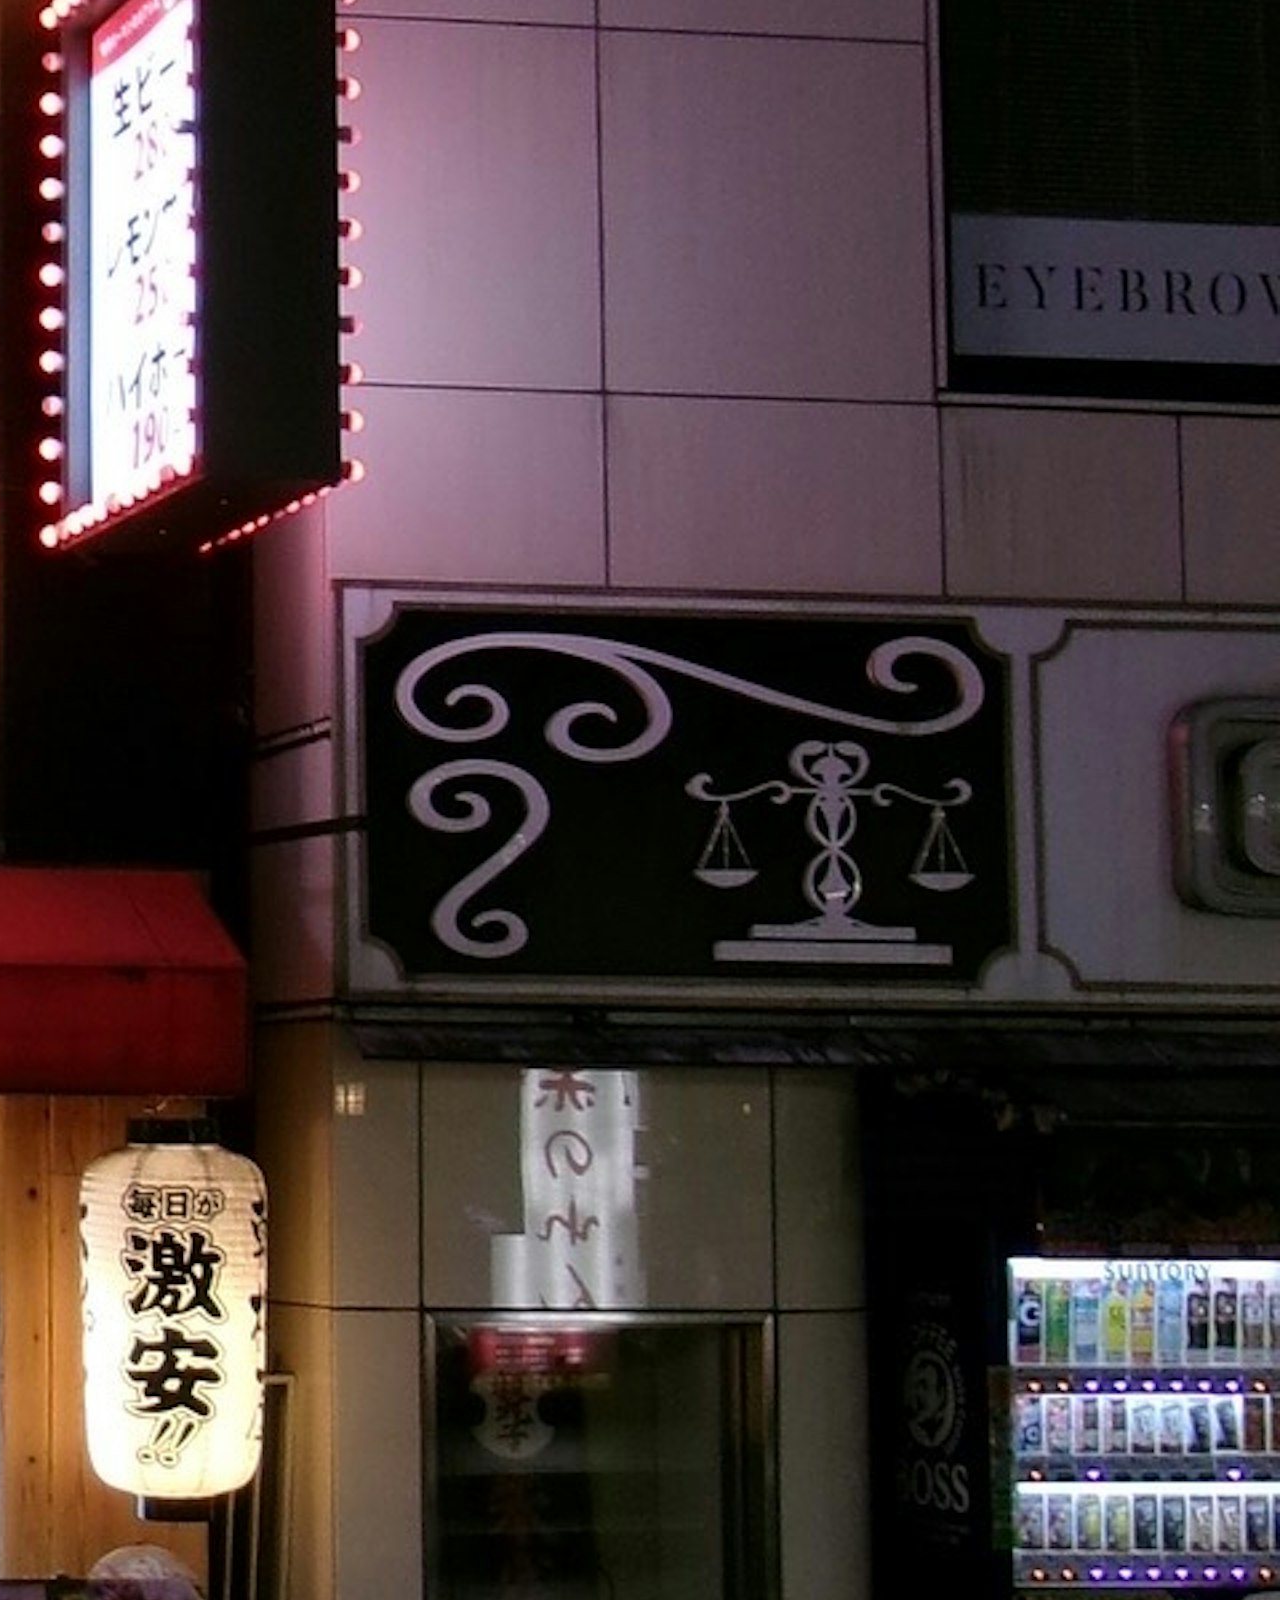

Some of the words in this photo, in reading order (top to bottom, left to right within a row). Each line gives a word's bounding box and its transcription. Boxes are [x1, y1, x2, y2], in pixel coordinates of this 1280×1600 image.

[125, 1187, 222, 1222] 毎日が
[900, 1459, 971, 1515] OSS
